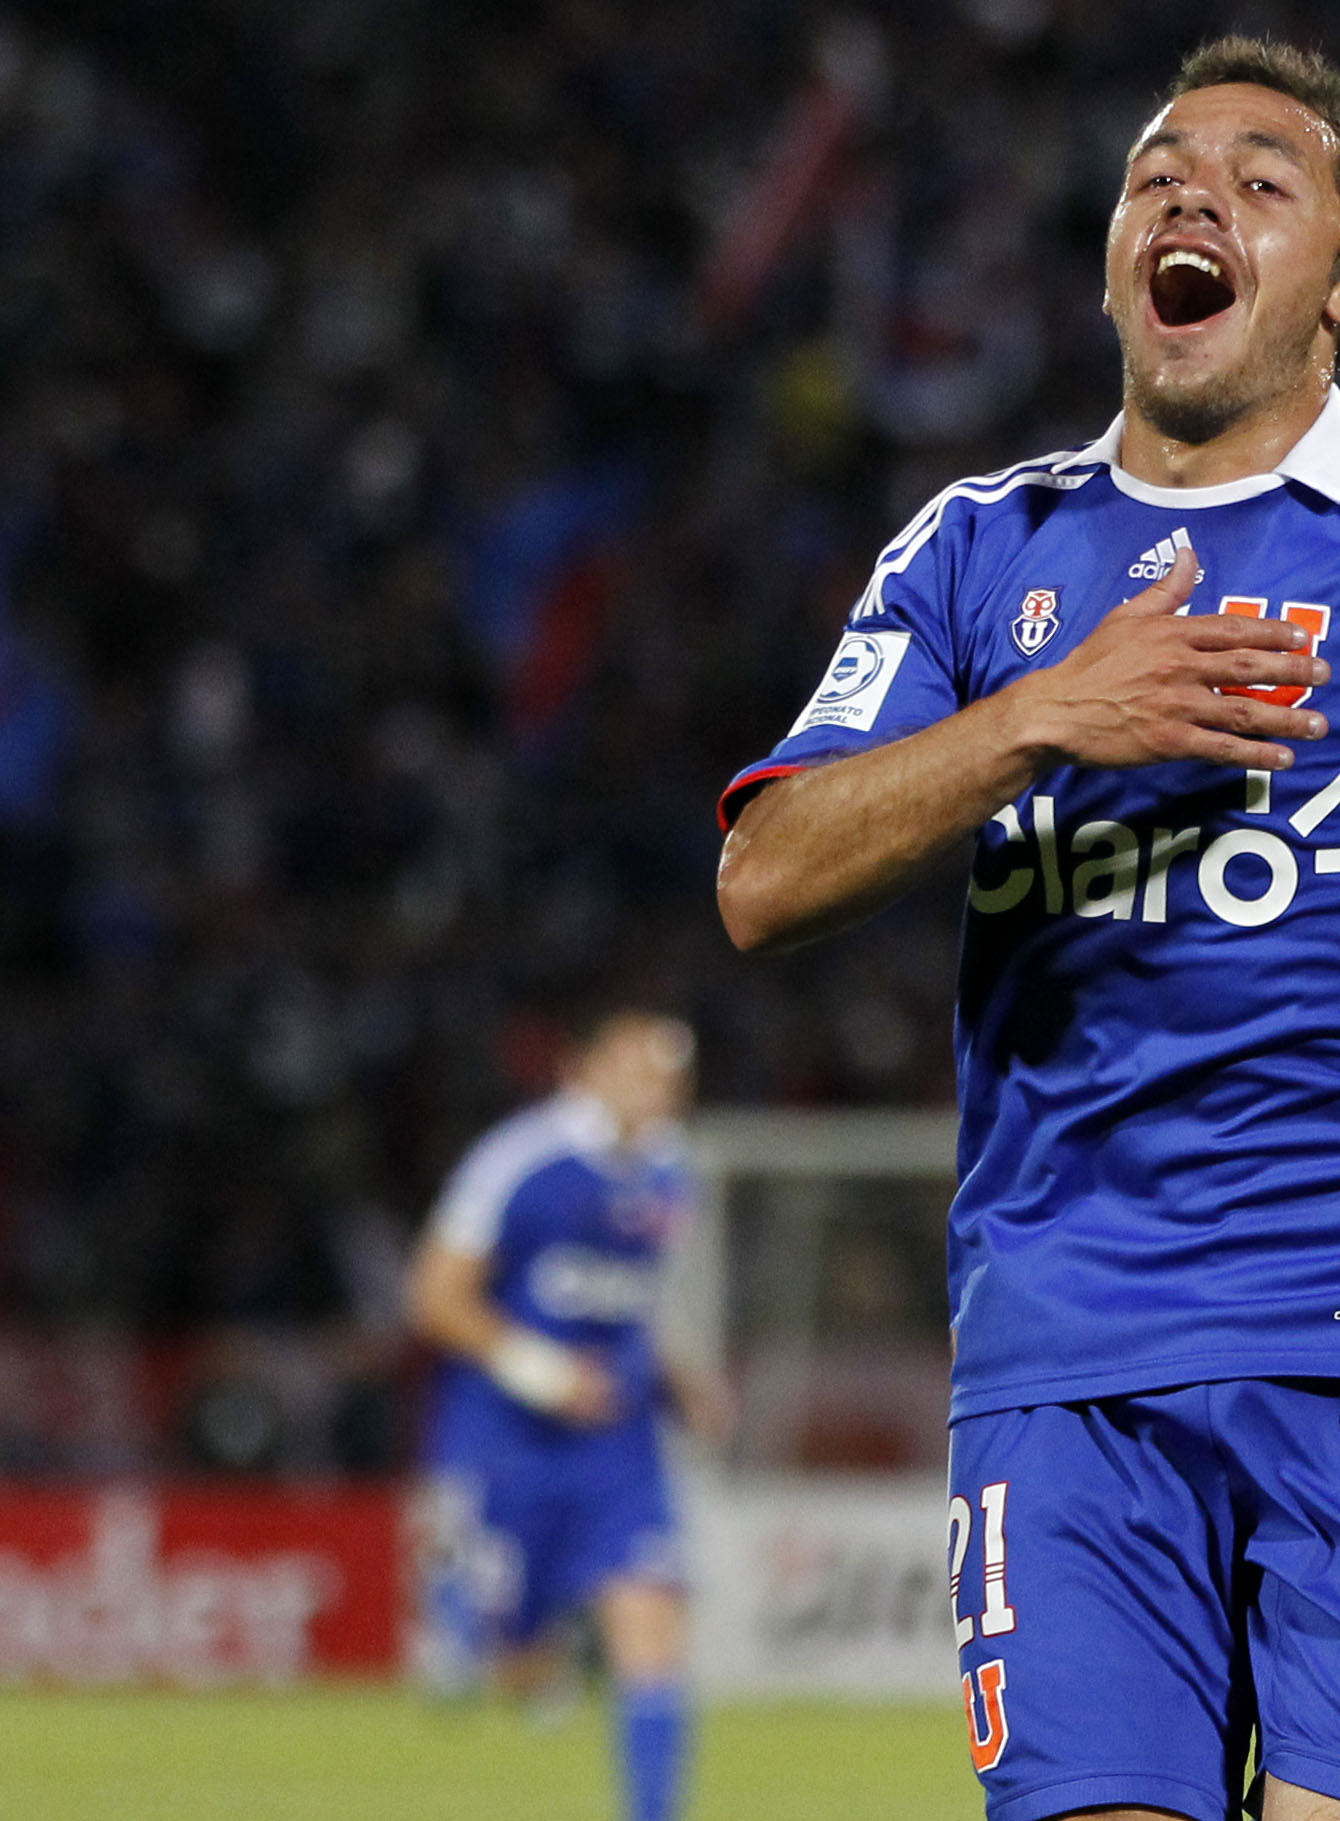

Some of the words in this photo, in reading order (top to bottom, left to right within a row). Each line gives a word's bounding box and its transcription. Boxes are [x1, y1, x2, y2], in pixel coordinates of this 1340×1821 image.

[1128, 562, 1205, 584] adis
[1021, 621, 1049, 648] U
[947, 1481, 1016, 1651] 21
